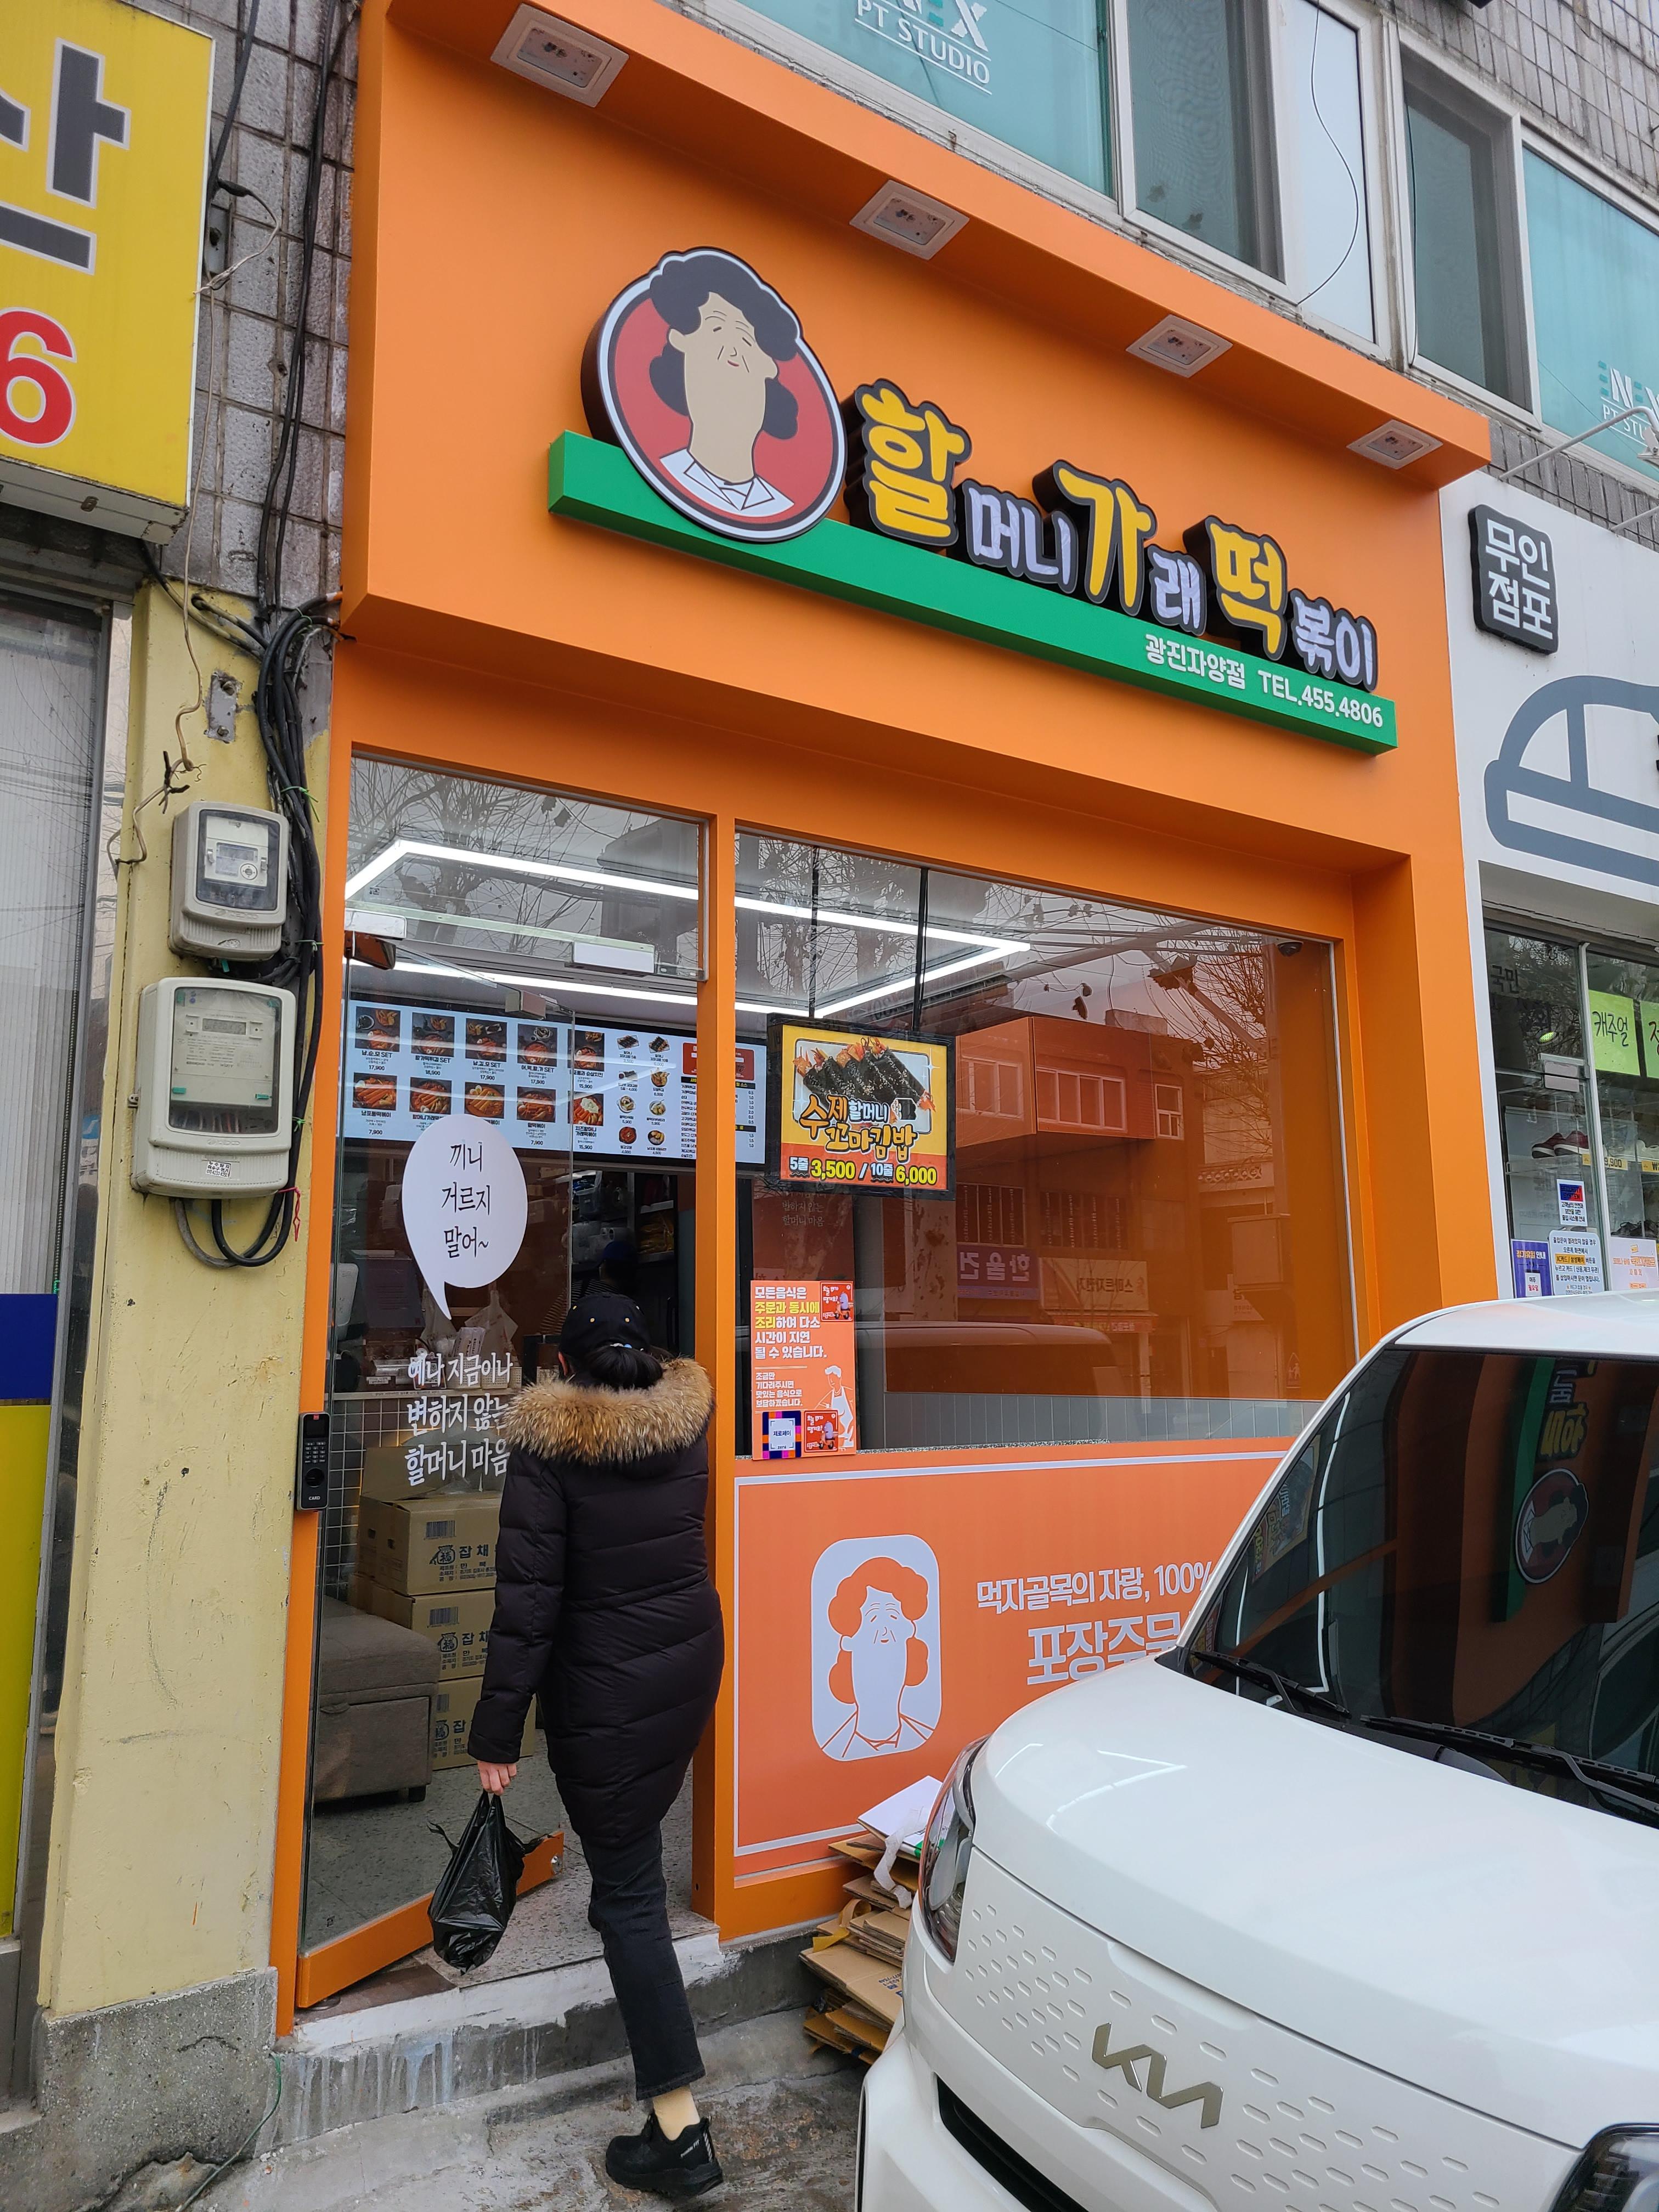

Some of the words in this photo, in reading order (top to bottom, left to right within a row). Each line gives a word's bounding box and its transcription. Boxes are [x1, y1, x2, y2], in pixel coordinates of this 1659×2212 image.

[857, 0, 889, 27] PT
[898, 18, 990, 84] STUDIO
[1485, 518, 1550, 590] 무인
[1488, 570, 1553, 640] 점포
[1146, 634, 1245, 689] 광진자양점
[1258, 669, 1383, 727] TEL.455.4806
[1592, 1011, 1629, 1047] 캐주얼
[799, 1094, 848, 1139] 수제
[849, 1100, 889, 1122] 할머니
[449, 1143, 483, 1172] 끼니
[825, 1125, 917, 1161] 꼬마김밥
[790, 1157, 809, 1170] 5줄
[811, 1159, 855, 1180] 3,500
[871, 1163, 894, 1176] 10줄
[895, 1165, 936, 1185] 6,000
[441, 1182, 490, 1216] 거르지
[782, 1200, 805, 1211] 변하지
[782, 1215, 806, 1226] 할머니
[808, 1216, 825, 1227] 마음
[443, 1226, 489, 1259] 말어~
[755, 1286, 806, 1299] 모든음식은
[755, 1302, 786, 1314] 주문과
[789, 1301, 820, 1313] 동시에
[755, 1316, 797, 1328] 조리하여
[799, 1316, 820, 1328] 다소
[755, 1331, 786, 1344] 시간이
[789, 1331, 810, 1343] 지연
[755, 1347, 765, 1359] 될
[769, 1346, 780, 1359] 수
[782, 1346, 827, 1358] 있습니다.
[447, 1352, 514, 1387] 지금이나
[755, 1381, 794, 1389] 기다려주시면
[756, 1390, 776, 1398] 맛있는
[776, 1390, 802, 1398] 음식으로
[756, 1398, 803, 1408] 보답하겠습니다.
[407, 1394, 468, 1436] 변하지
[405, 1440, 467, 1486] 할머니
[471, 1438, 511, 1477] 마음
[977, 1571, 1094, 1614] 먹자골목의
[1098, 1566, 1150, 1604] 자랑,
[1154, 1561, 1215, 1596] 100%
[1092, 2022, 1224, 2129] KIA
